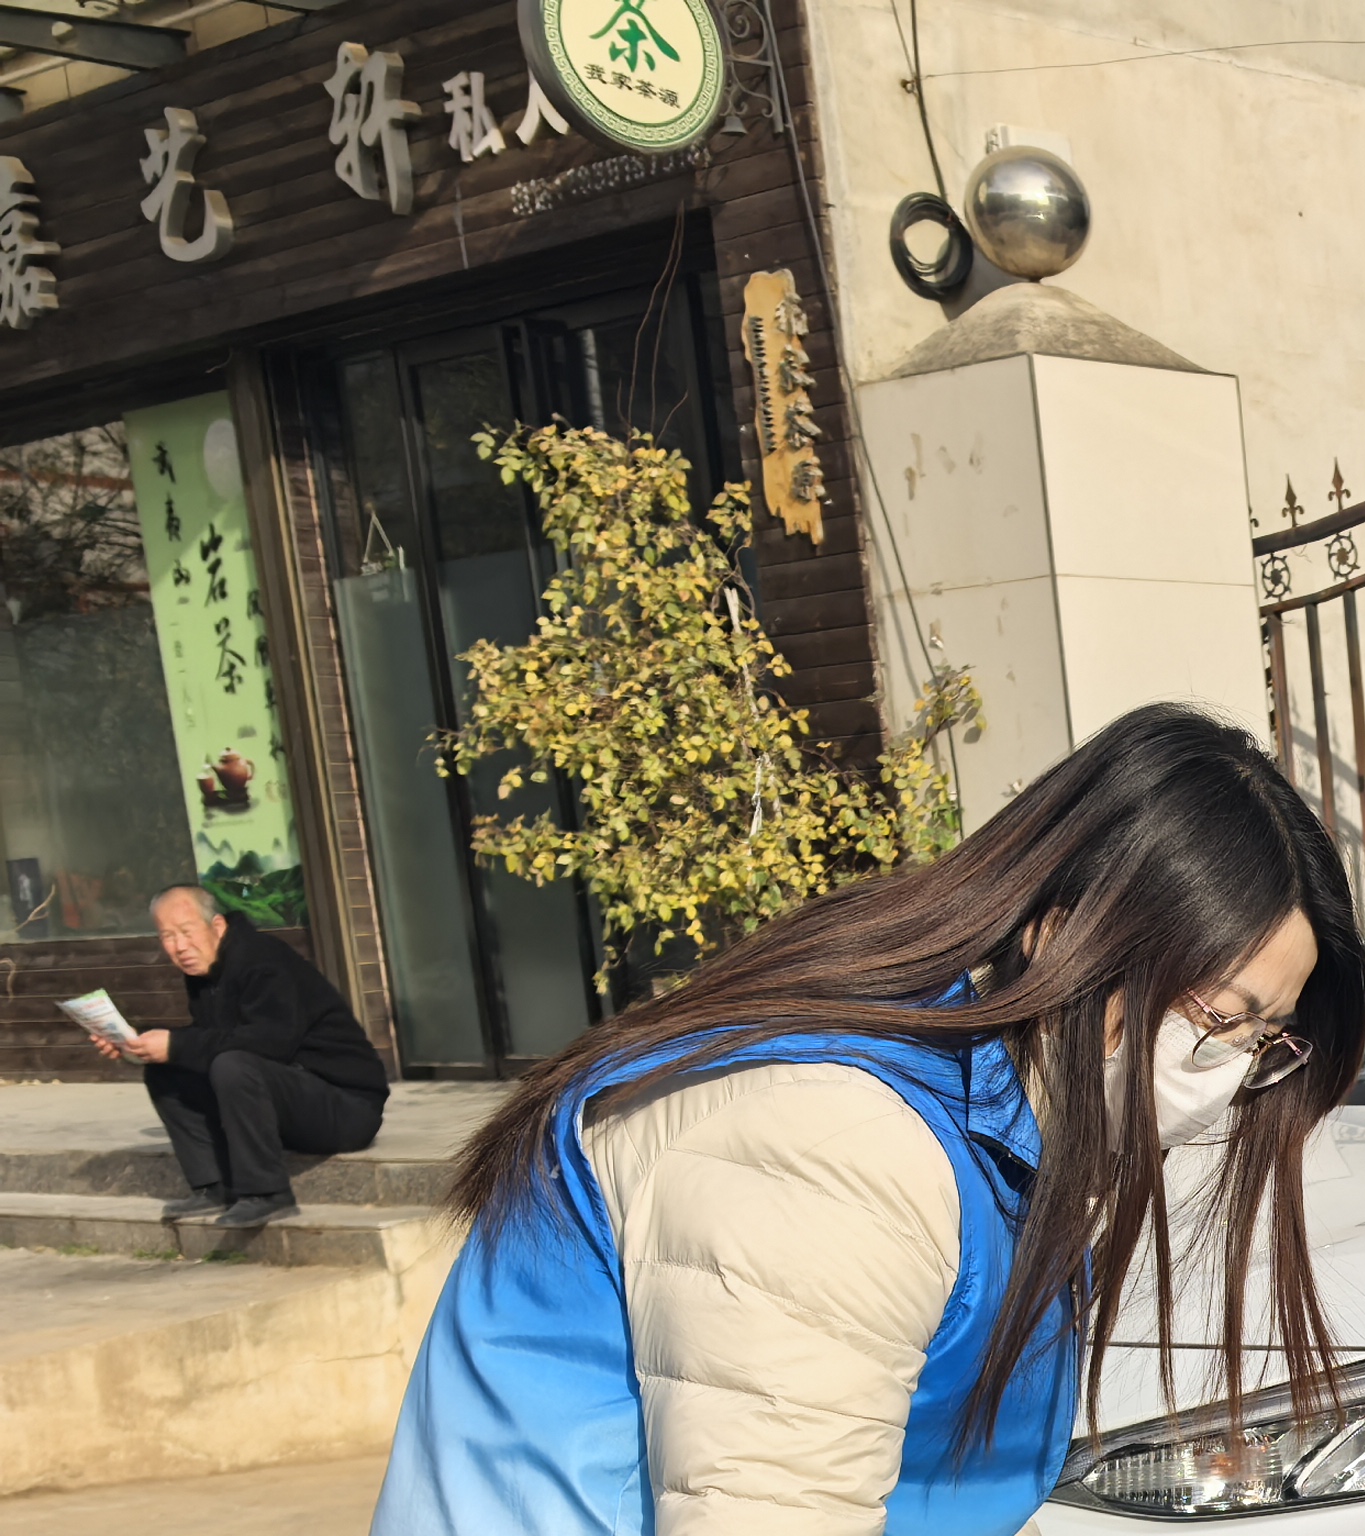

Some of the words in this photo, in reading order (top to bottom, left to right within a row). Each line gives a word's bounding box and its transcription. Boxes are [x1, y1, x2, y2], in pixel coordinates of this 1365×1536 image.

[589, 0, 681, 72] 茶
[583, 63, 681, 109] 我家茶源
